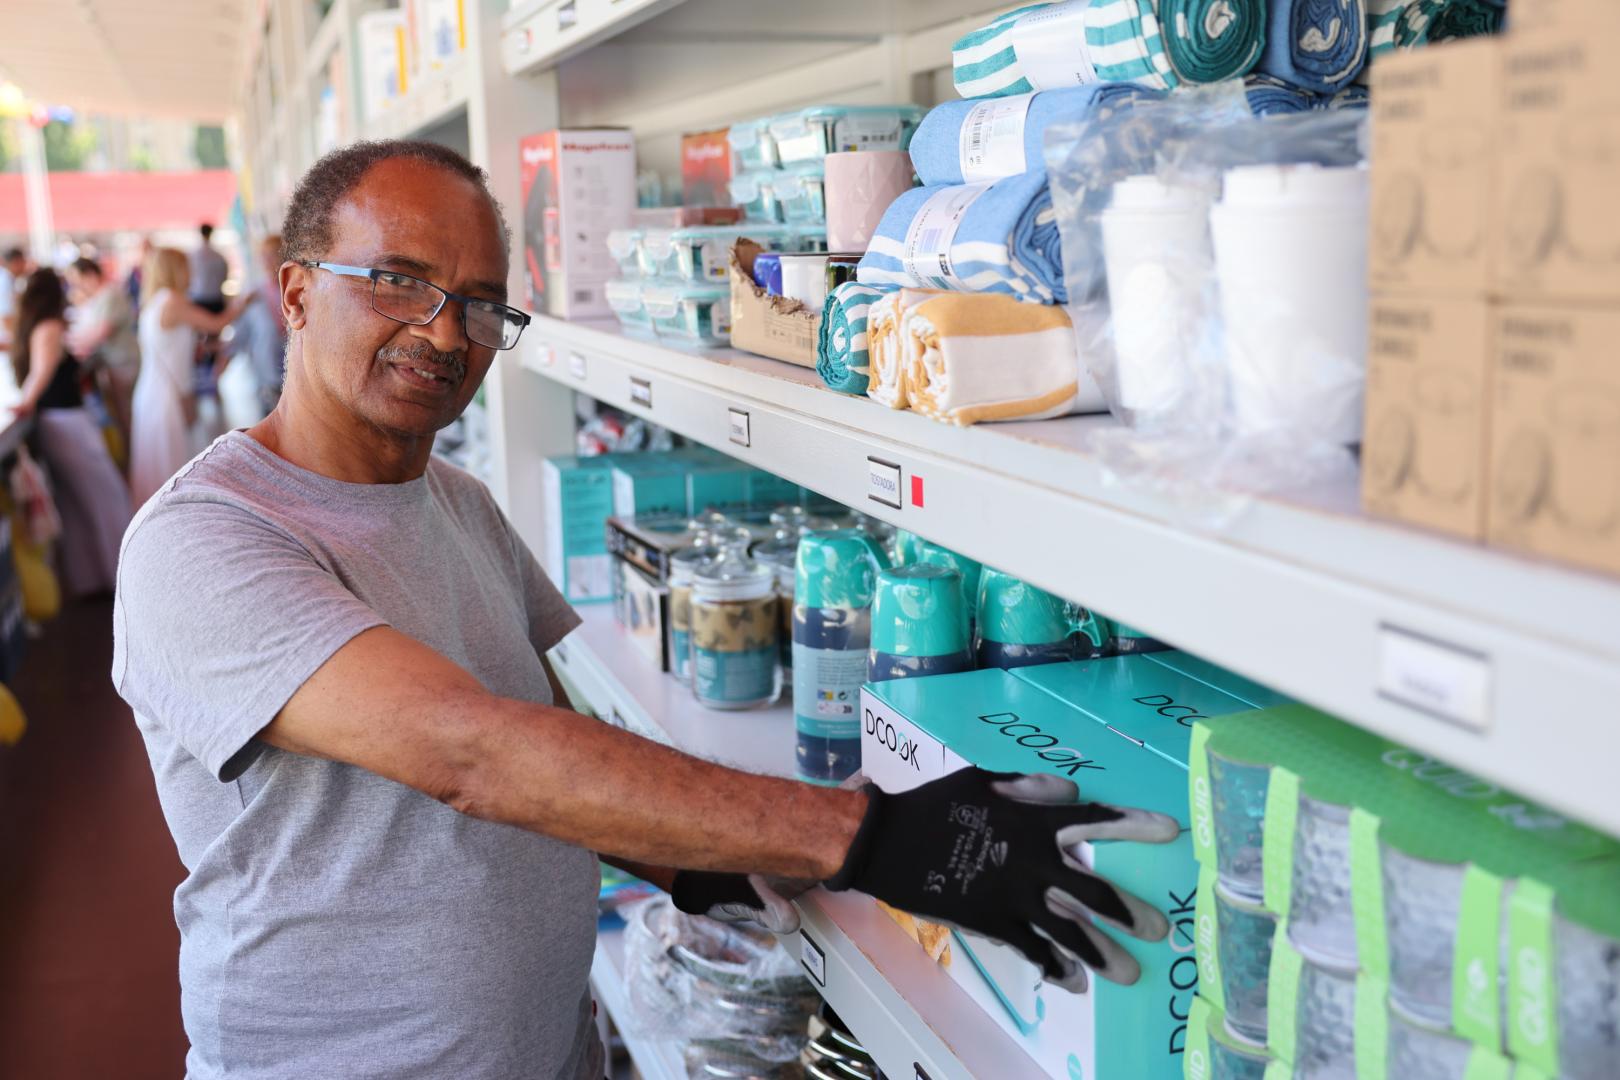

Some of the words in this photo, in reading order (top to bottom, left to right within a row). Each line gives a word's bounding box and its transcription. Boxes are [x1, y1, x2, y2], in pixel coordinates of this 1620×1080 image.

[865, 708, 920, 771] DCOOK
[977, 712, 1106, 776] DCOOK
[1194, 775, 1211, 849] QUID
[1168, 887, 1200, 1055] DCOOK
[1199, 914, 1216, 985] QUID
